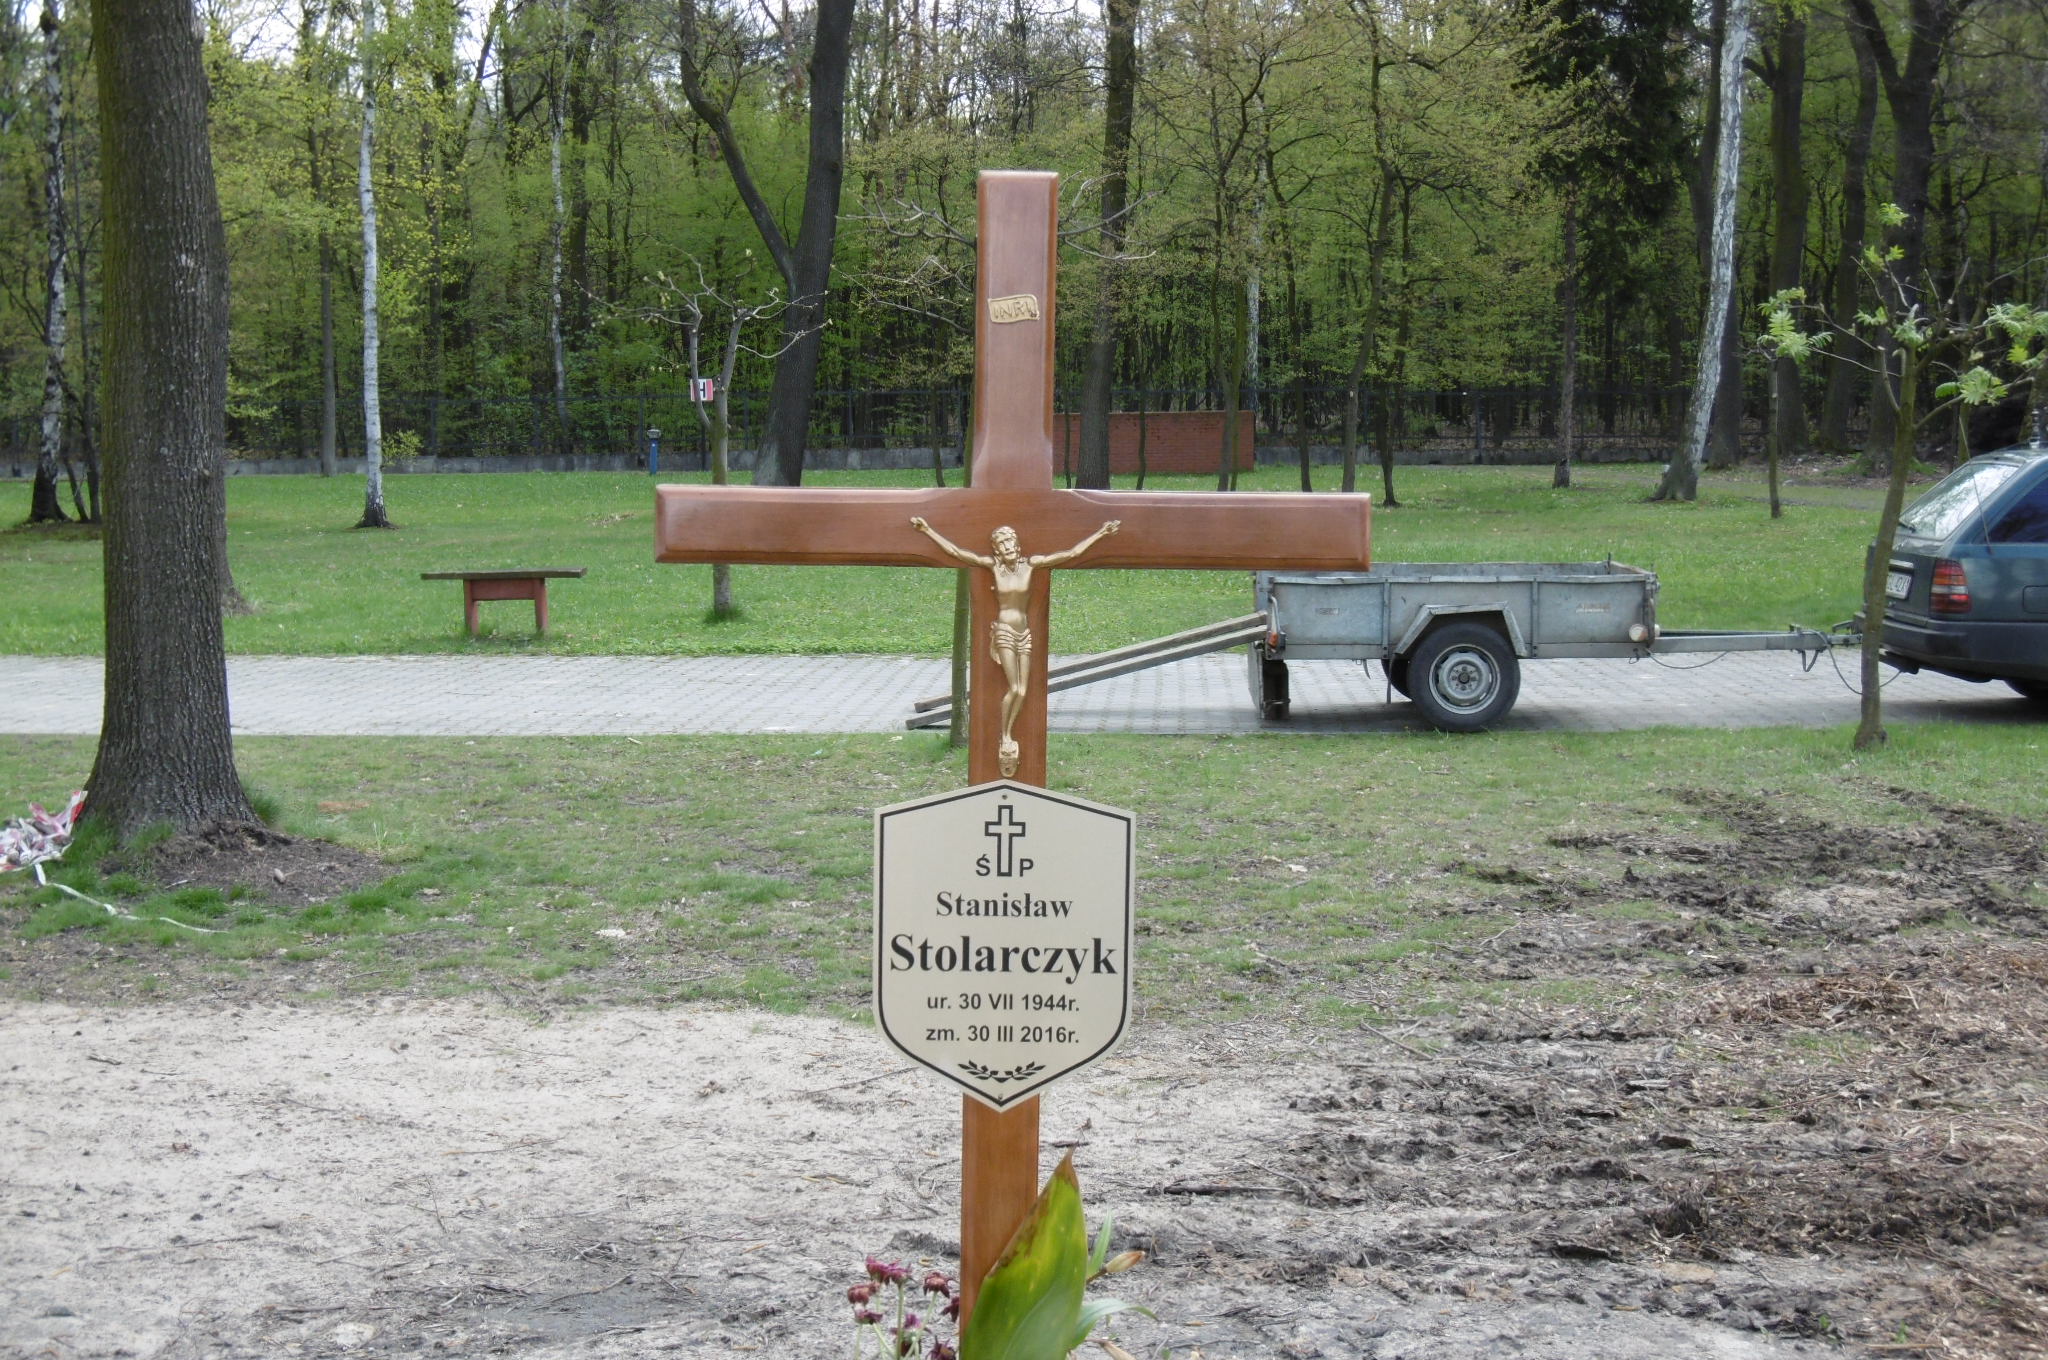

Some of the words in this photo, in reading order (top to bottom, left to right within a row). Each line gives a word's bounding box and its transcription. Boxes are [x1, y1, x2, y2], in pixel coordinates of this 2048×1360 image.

[975, 853, 991, 877] Ś
[1019, 857, 1034, 878] P
[936, 891, 1073, 919] Stanisław
[890, 933, 1118, 985] Stolarczyk
[927, 996, 951, 1010] ur.
[958, 993, 982, 1010] 30
[988, 993, 1014, 1011] VII
[1021, 993, 1080, 1012] 1944r.
[925, 1027, 960, 1042] zm.
[967, 1024, 990, 1042] 30
[997, 1025, 1014, 1043] III
[1020, 1025, 1079, 1044] 2016r.
